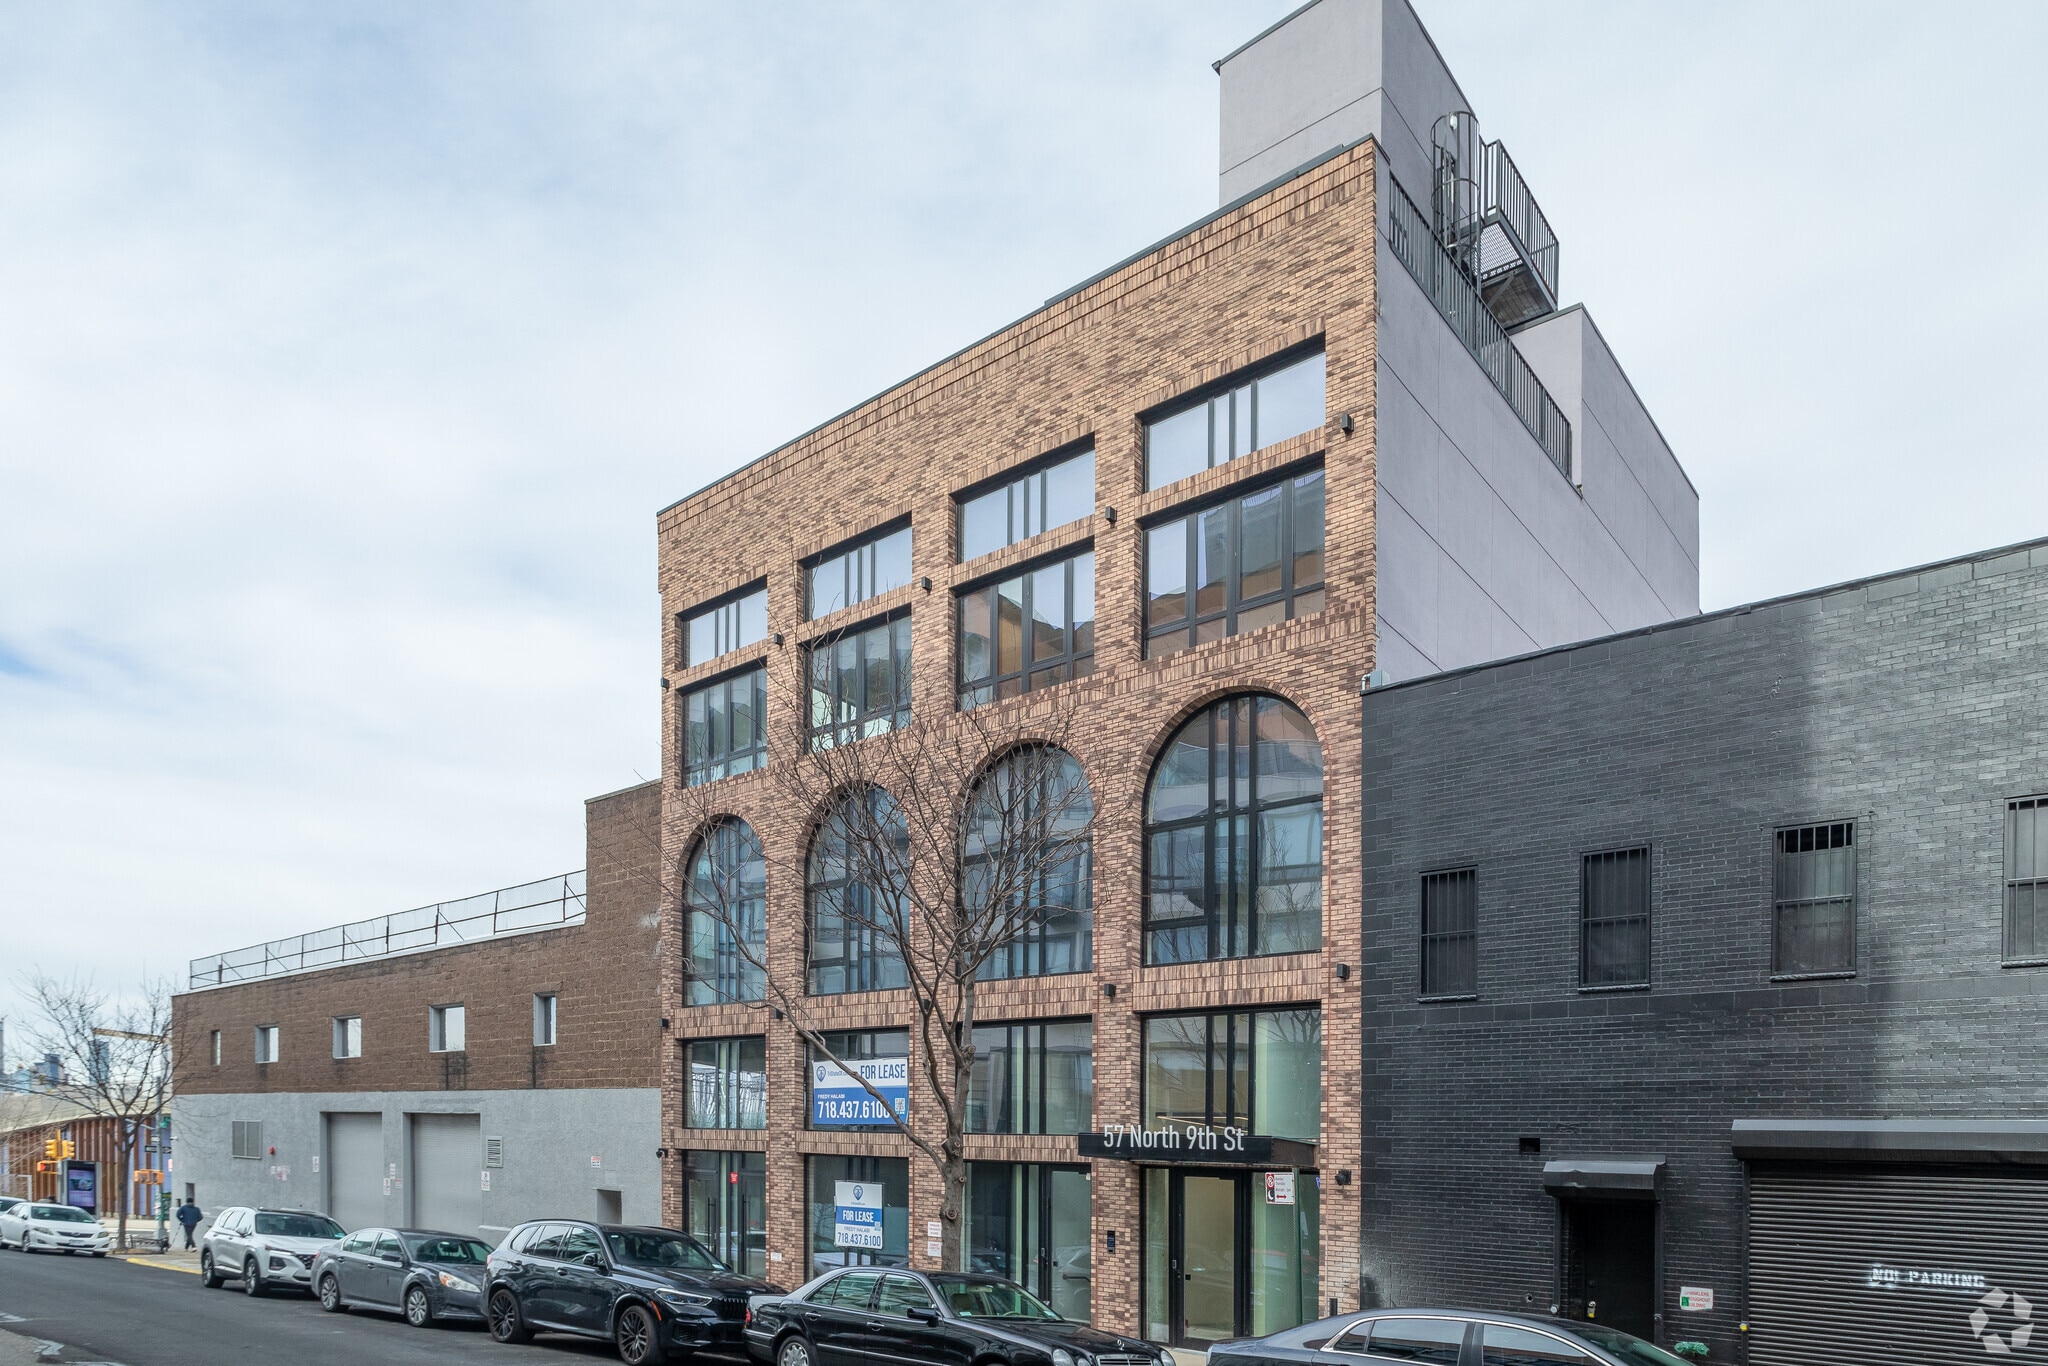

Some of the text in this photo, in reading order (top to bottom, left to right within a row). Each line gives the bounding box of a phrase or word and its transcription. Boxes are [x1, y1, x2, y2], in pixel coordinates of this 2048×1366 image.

[860, 1065, 876, 1080] FOR
[878, 1064, 905, 1079] LEASE
[1104, 1125, 1244, 1151] 57 North 9th St
[843, 1210, 874, 1222] FOR LEASE
[838, 1232, 880, 1247] 718.437.6100
[1908, 1270, 1985, 1287] PARKING
